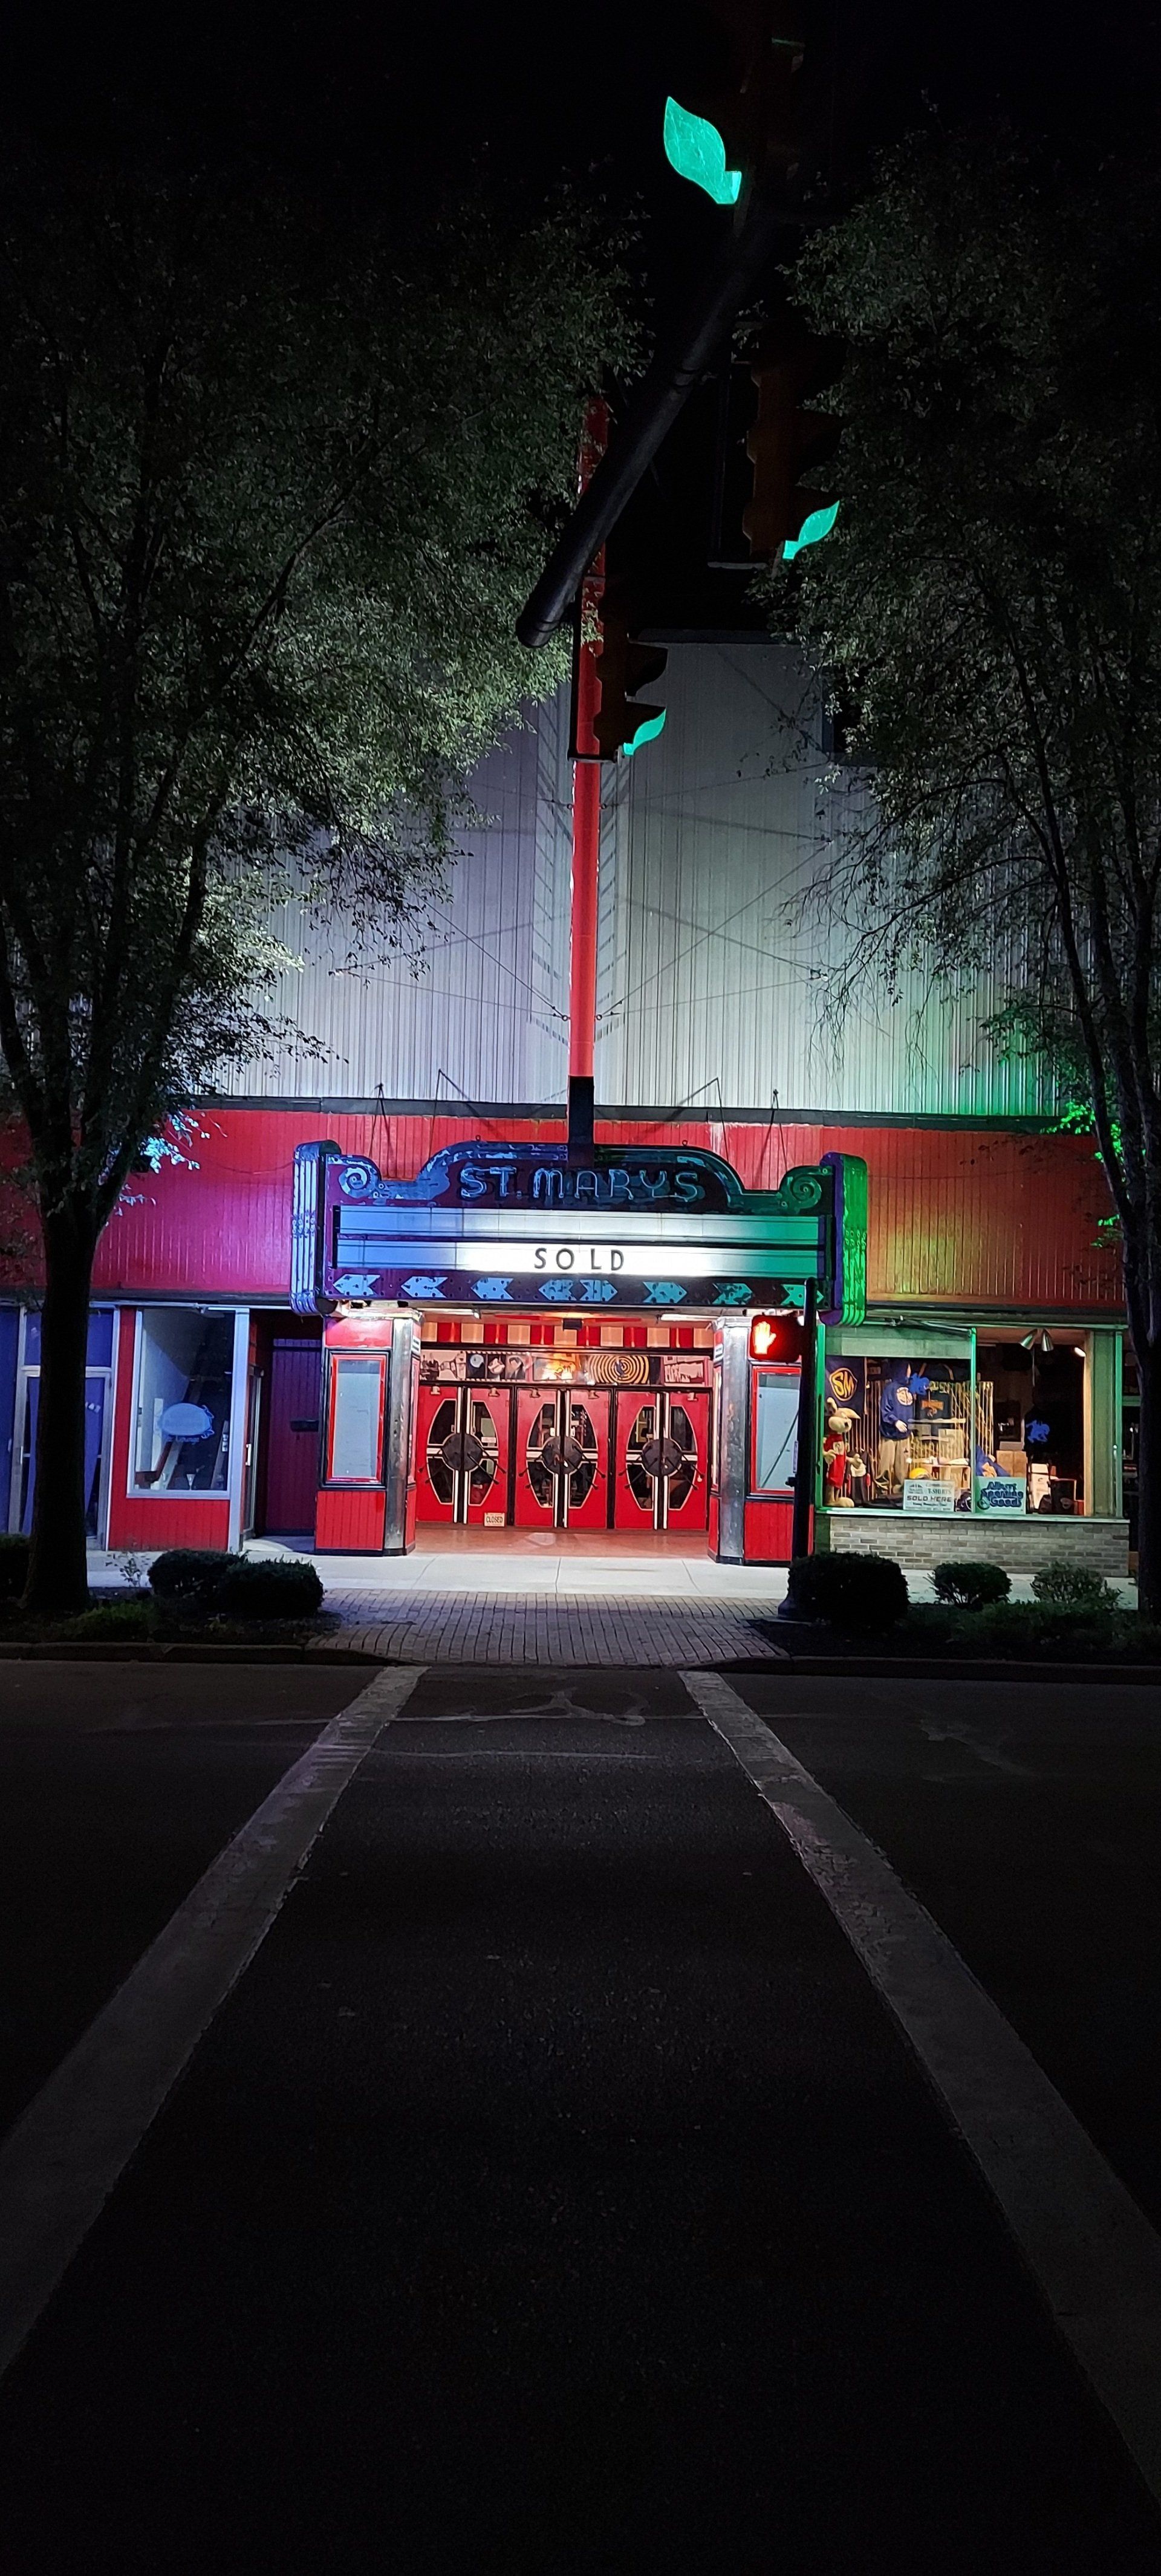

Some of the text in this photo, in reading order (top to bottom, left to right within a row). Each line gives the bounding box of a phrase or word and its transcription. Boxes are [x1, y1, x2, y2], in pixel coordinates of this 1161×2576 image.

[461, 1167, 700, 1202] ST. MARYS
[534, 1247, 625, 1270] SOLD
[831, 1371, 854, 1397] SM
